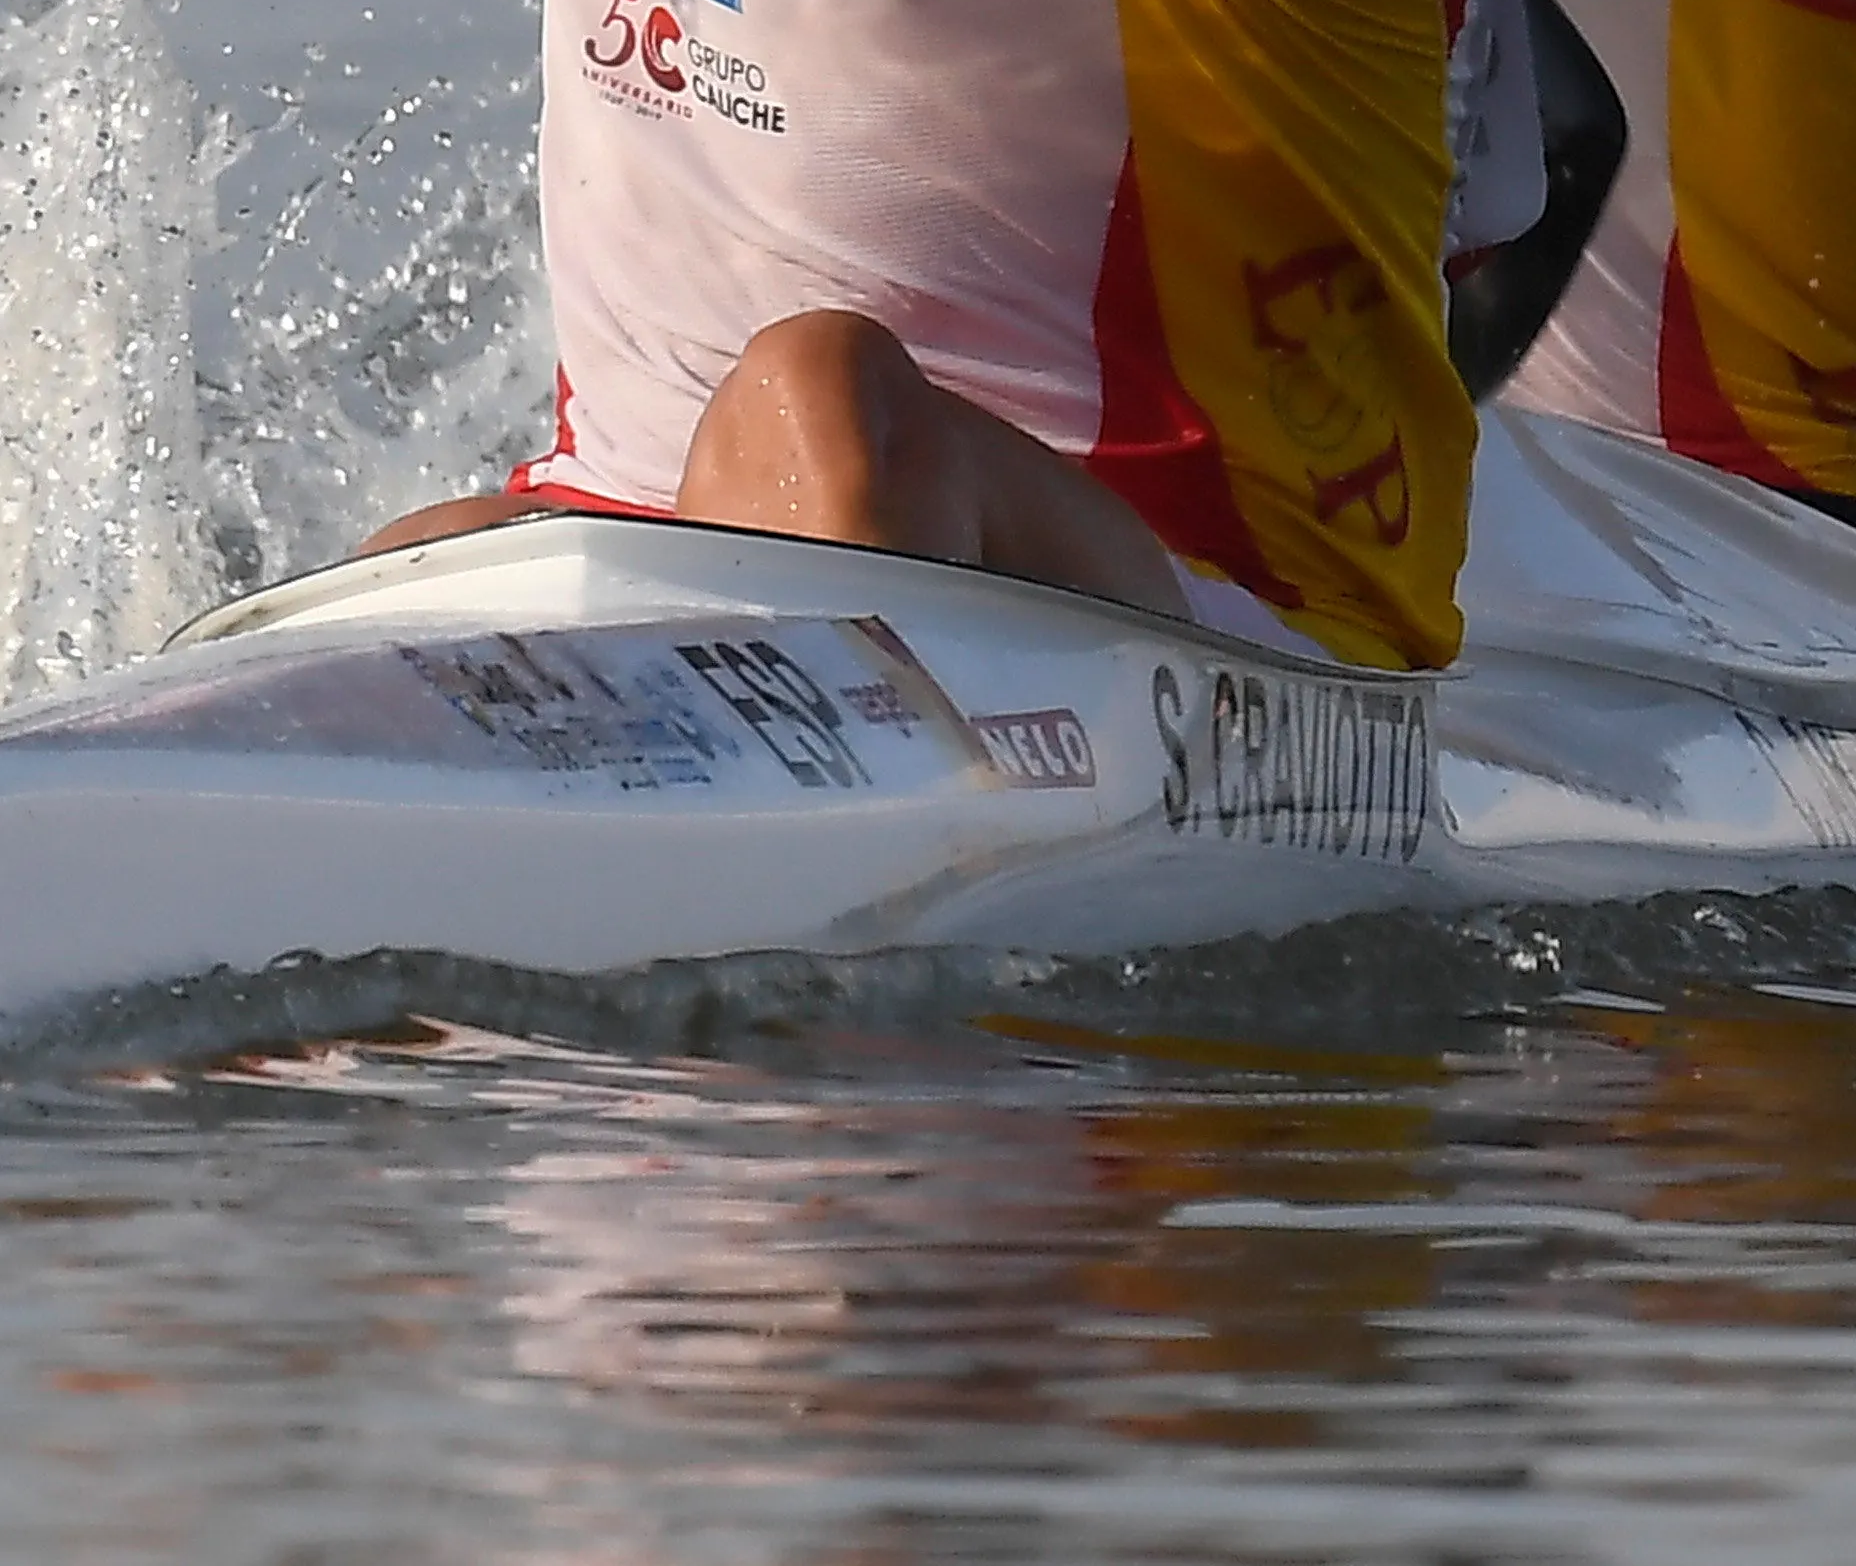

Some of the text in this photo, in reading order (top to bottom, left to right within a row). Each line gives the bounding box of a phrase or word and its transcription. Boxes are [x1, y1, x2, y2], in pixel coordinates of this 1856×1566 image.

[688, 38, 765, 92] GRUPO
[674, 639, 873, 788] ESP
[980, 721, 1091, 779] NELO
